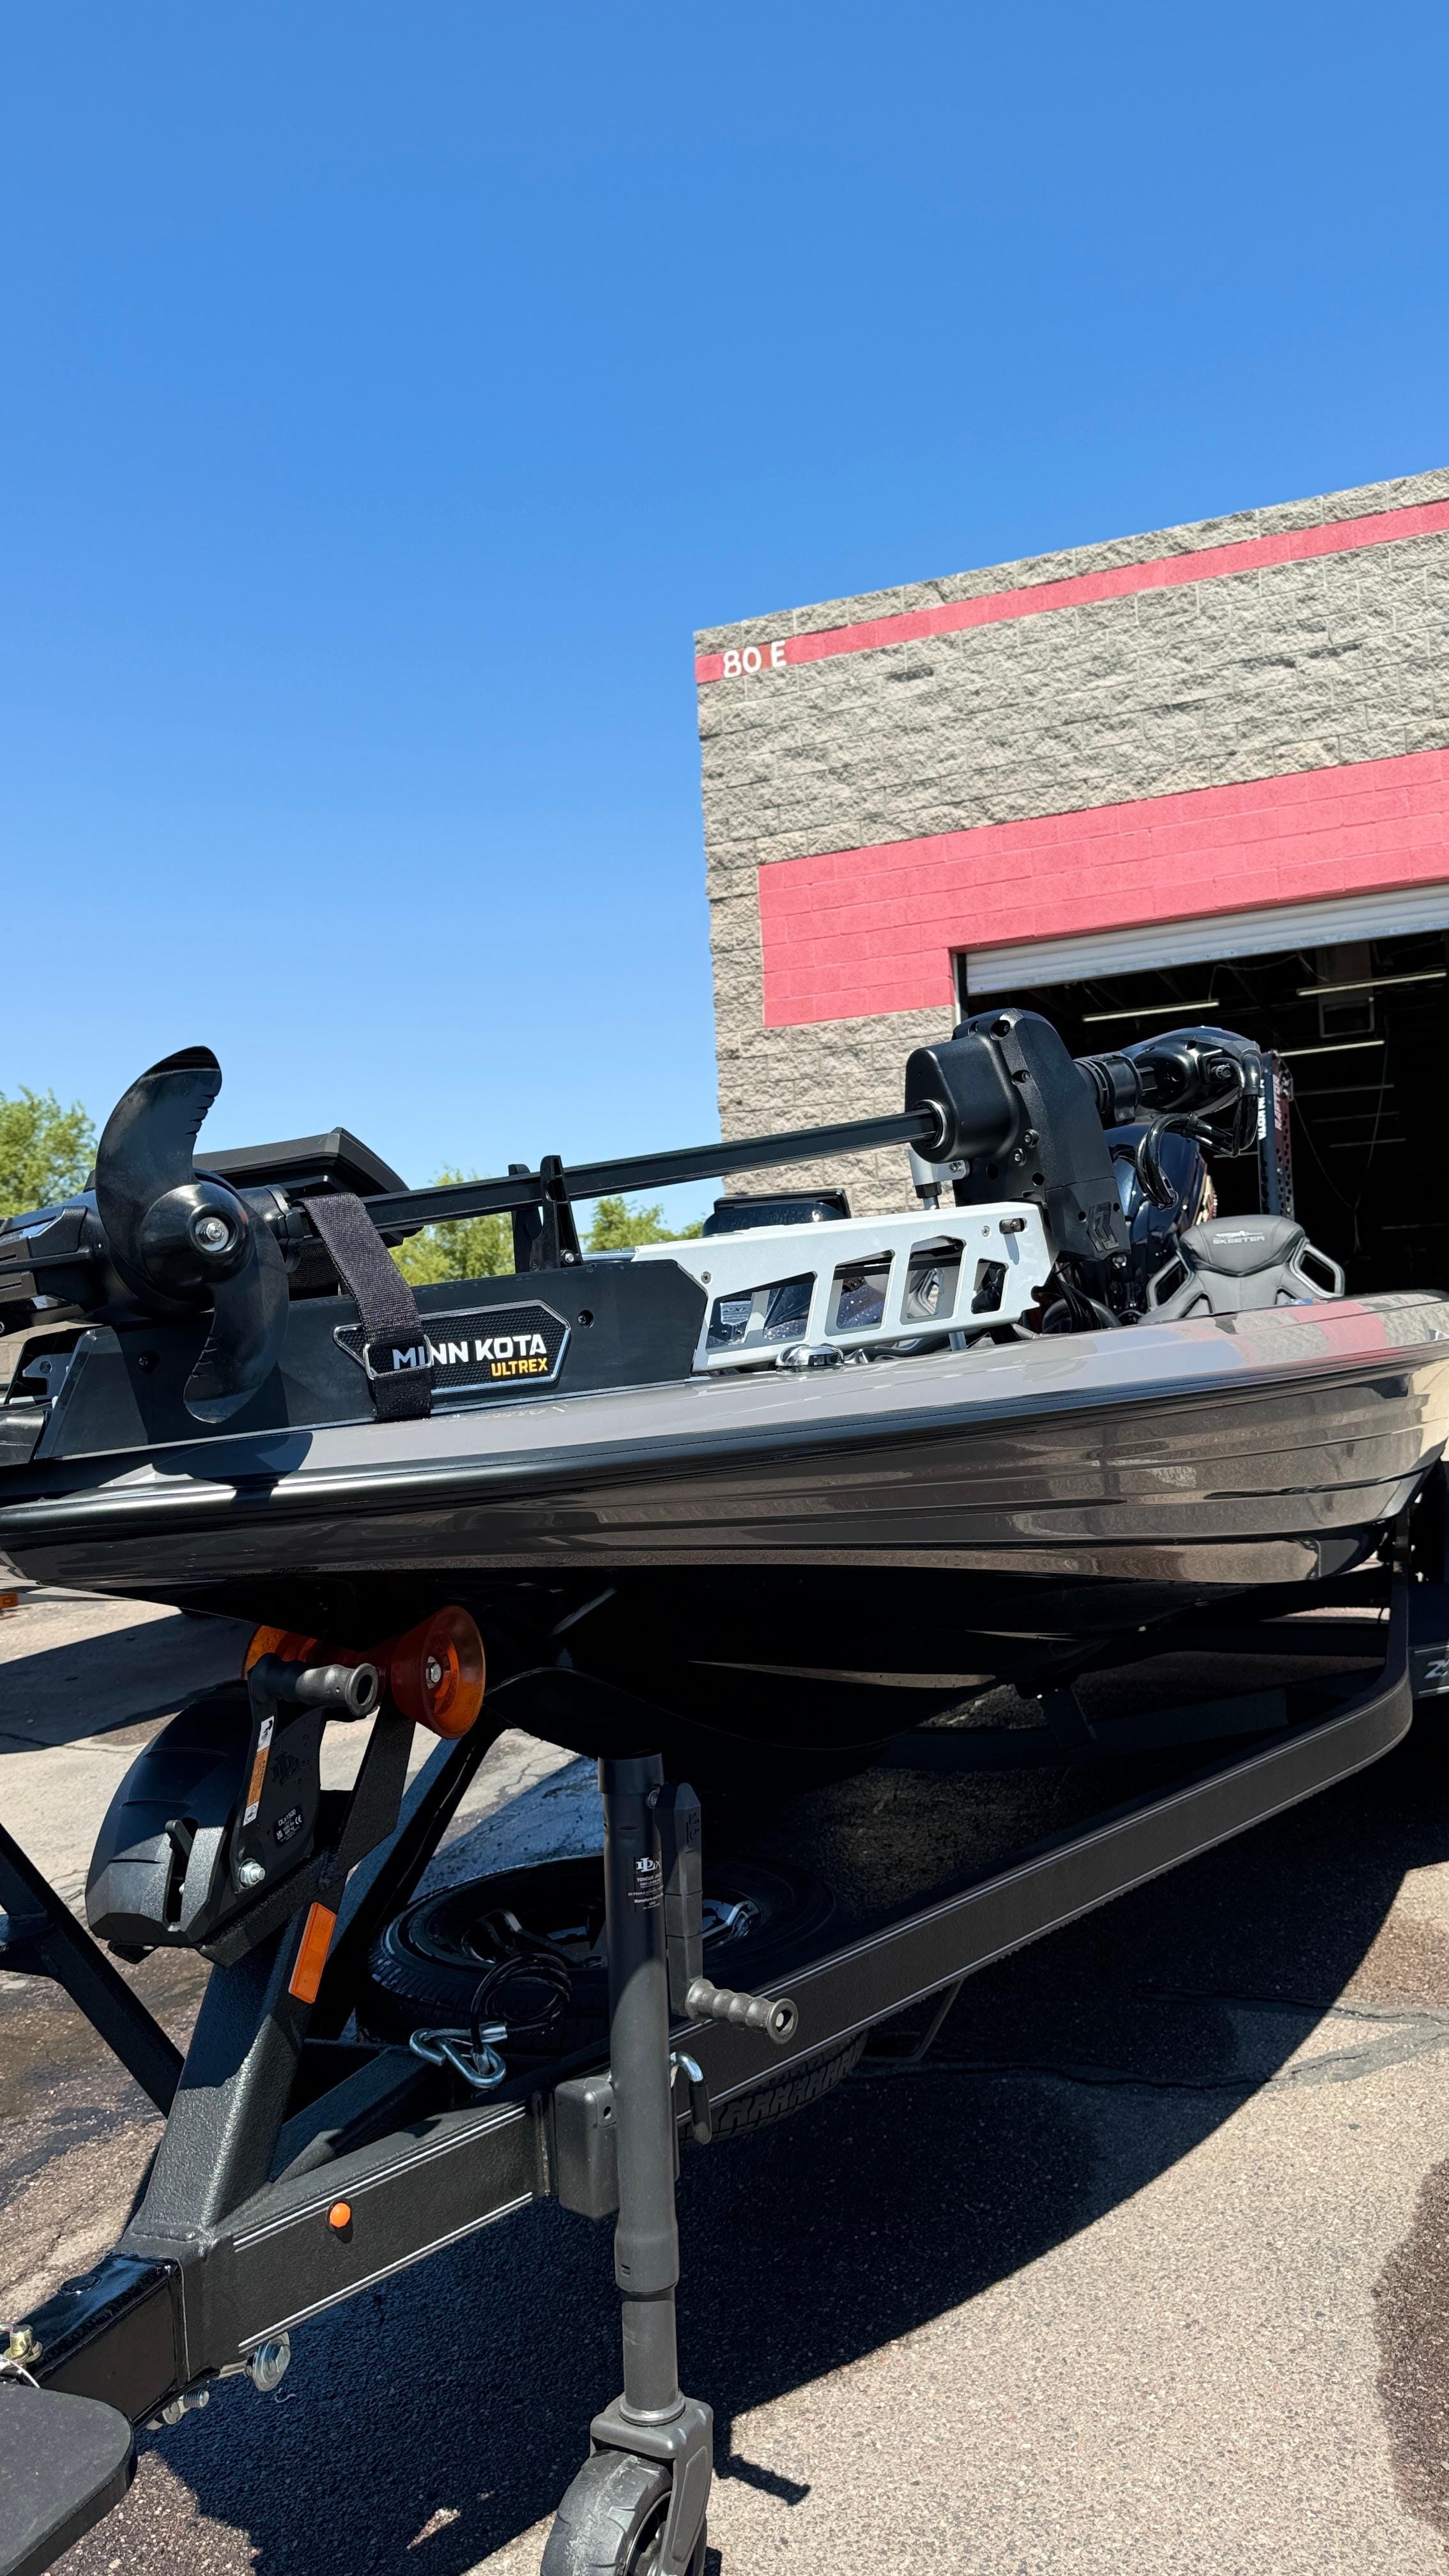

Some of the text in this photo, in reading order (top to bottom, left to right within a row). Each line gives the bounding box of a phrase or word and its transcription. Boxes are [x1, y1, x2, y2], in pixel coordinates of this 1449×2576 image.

[723, 640, 787, 678] 80 E
[1213, 1236, 1265, 1245] SKEETER
[392, 1334, 547, 1370] MINN KOTA
[491, 1358, 548, 1377] ULTREX
